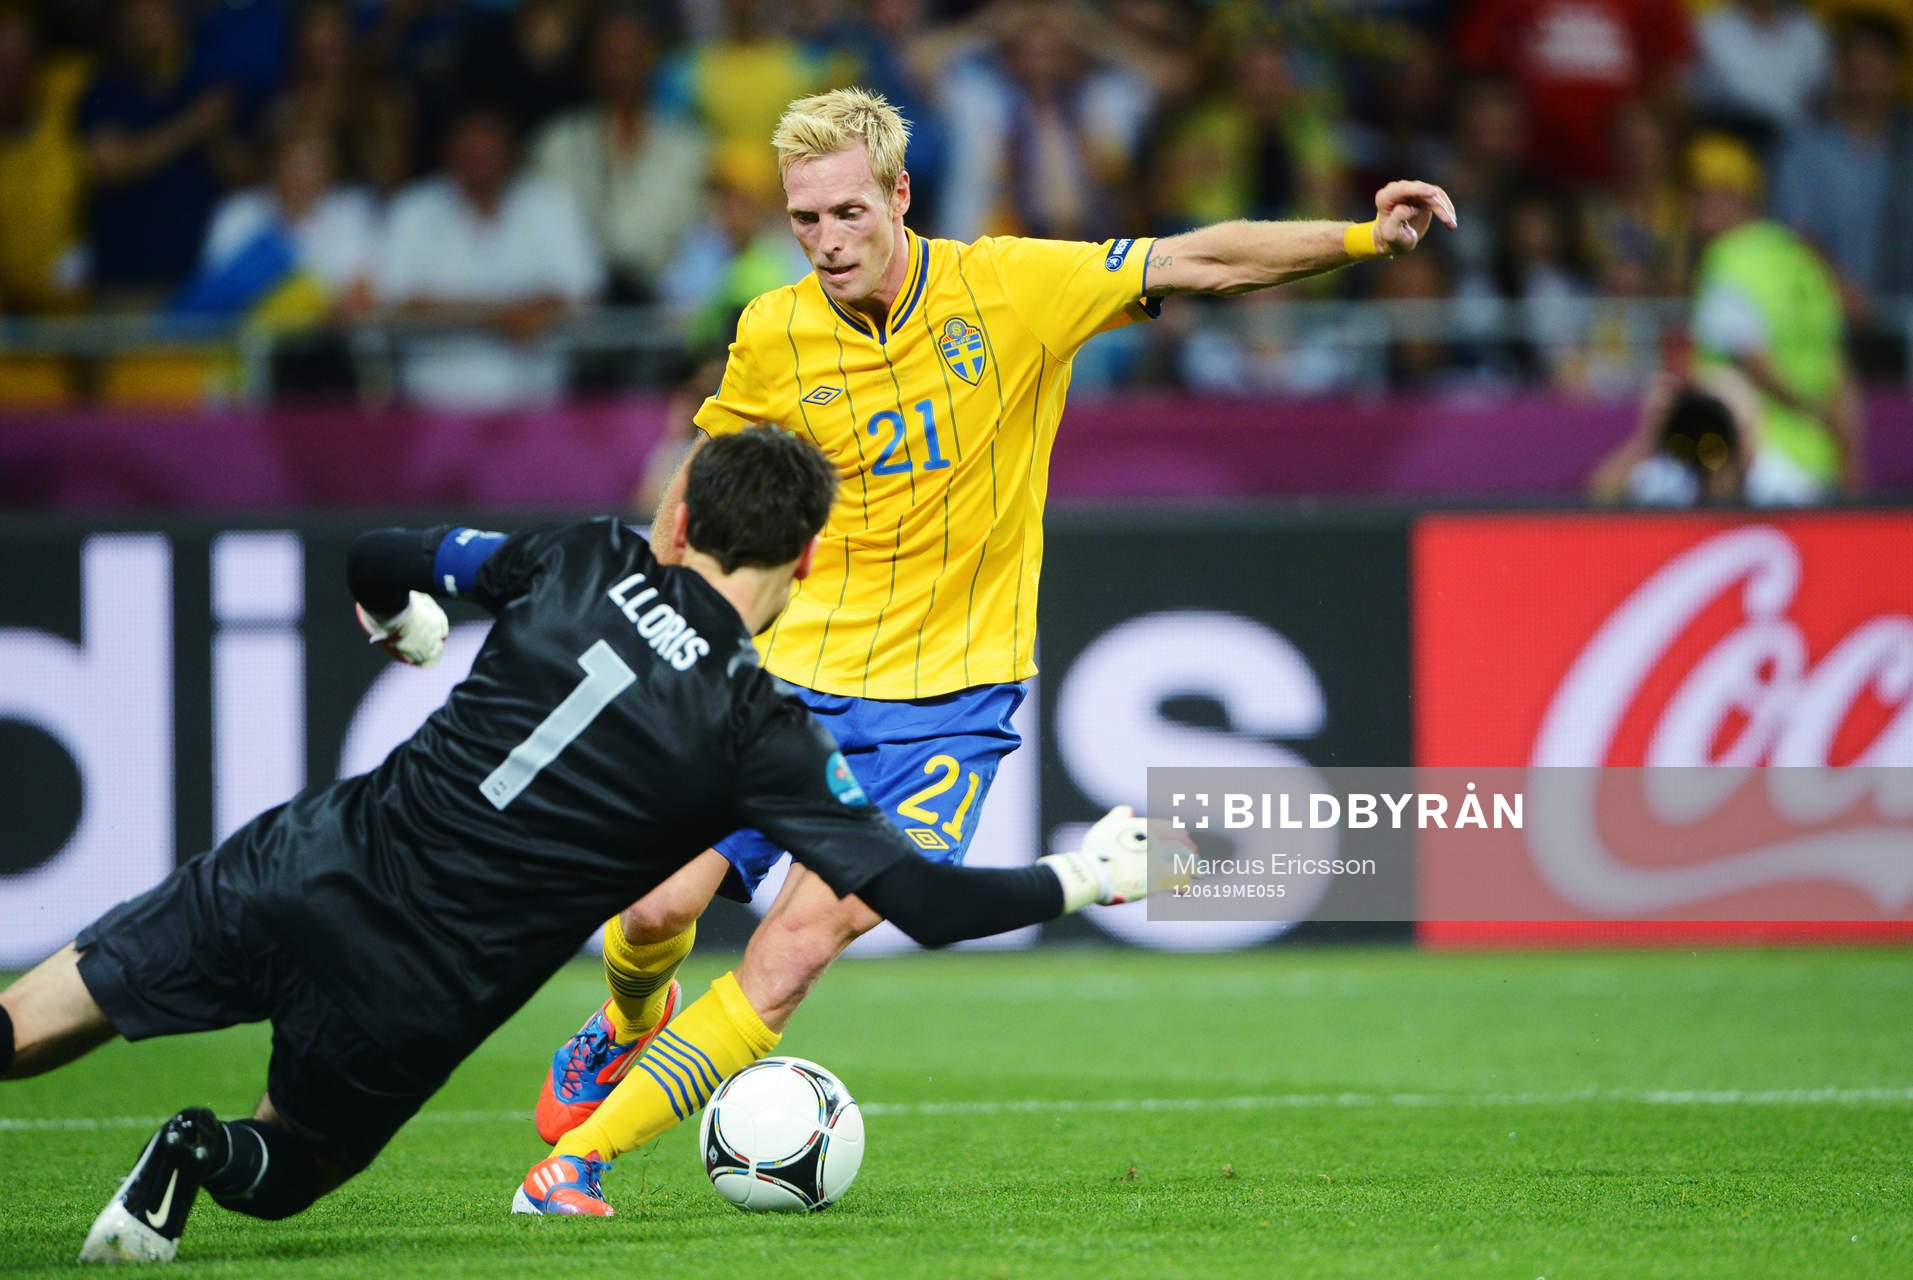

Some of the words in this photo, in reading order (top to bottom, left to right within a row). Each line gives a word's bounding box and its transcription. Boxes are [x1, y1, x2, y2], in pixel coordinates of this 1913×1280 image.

[867, 399, 951, 476] 21
[608, 573, 711, 671] LLORIS
[478, 638, 638, 812] 1
[1527, 524, 1913, 917] Coc
[897, 755, 980, 842] 21
